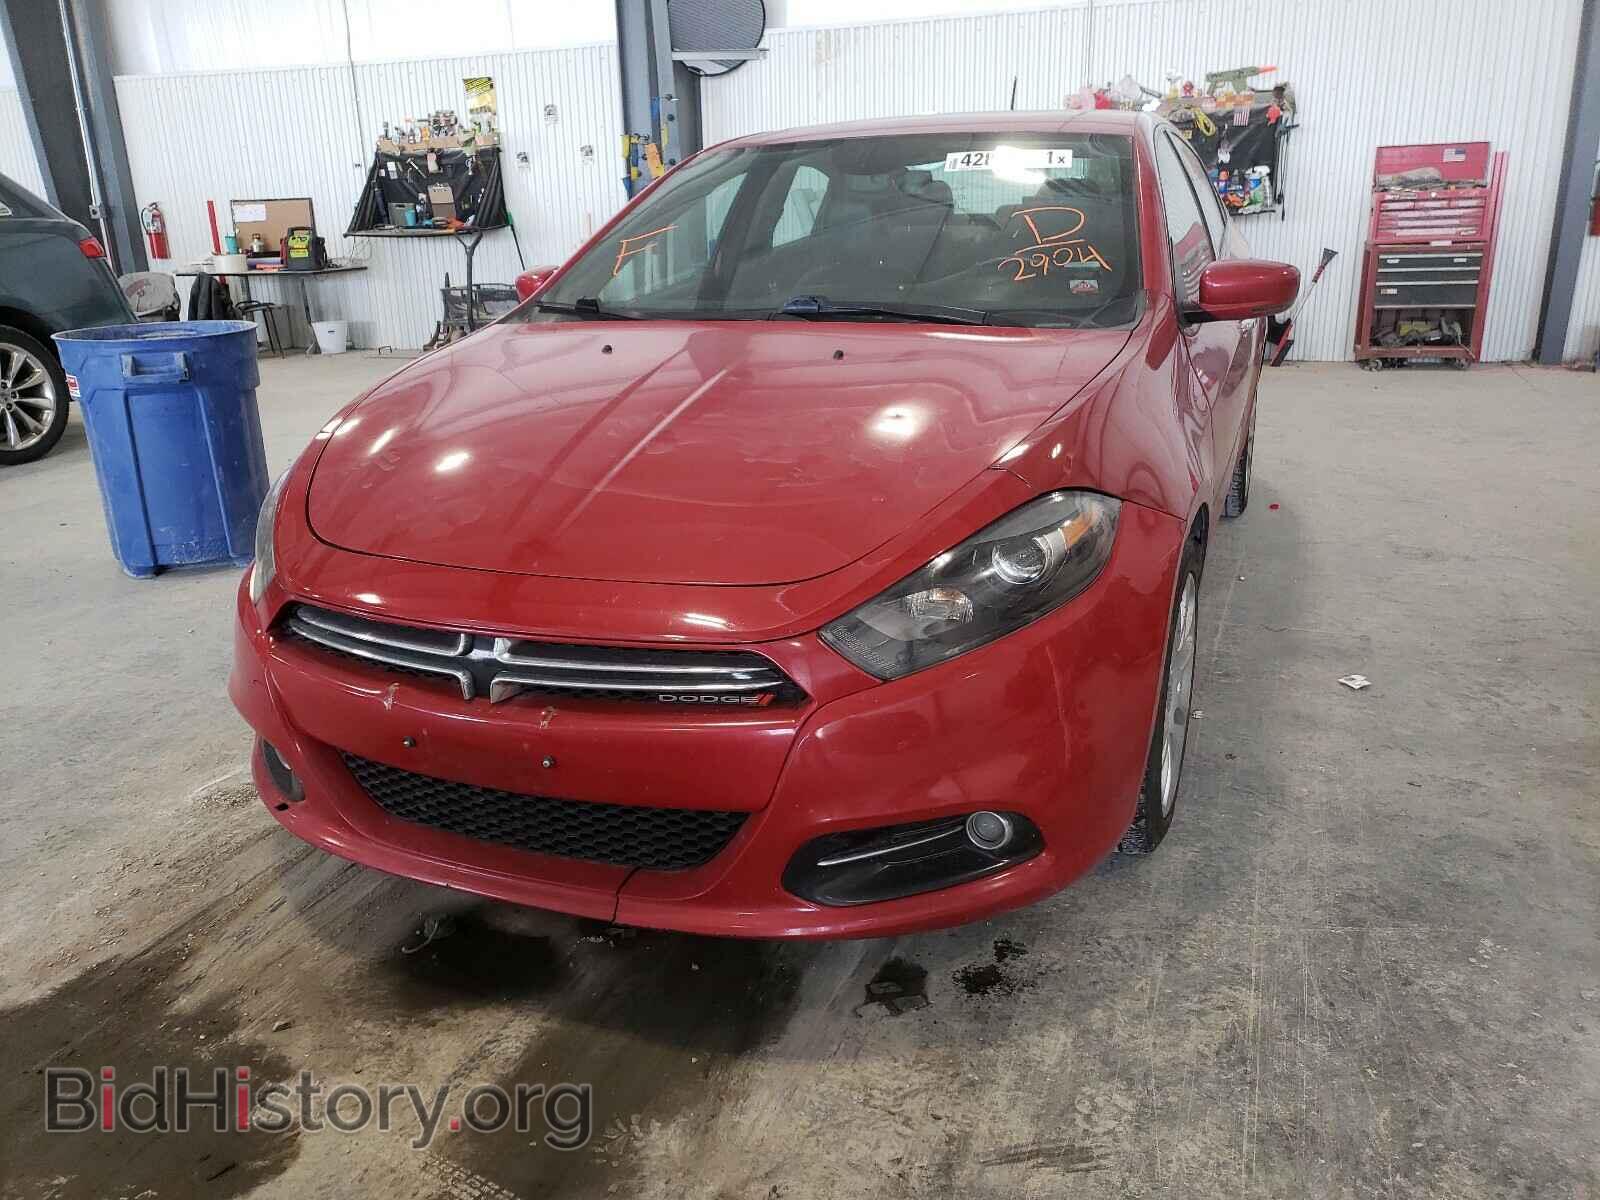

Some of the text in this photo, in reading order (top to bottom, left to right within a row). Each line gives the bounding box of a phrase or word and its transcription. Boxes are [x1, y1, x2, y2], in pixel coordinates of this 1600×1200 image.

[1011, 206, 1086, 245] D
[613, 224, 678, 276] F
[658, 693, 760, 704] DODGE
